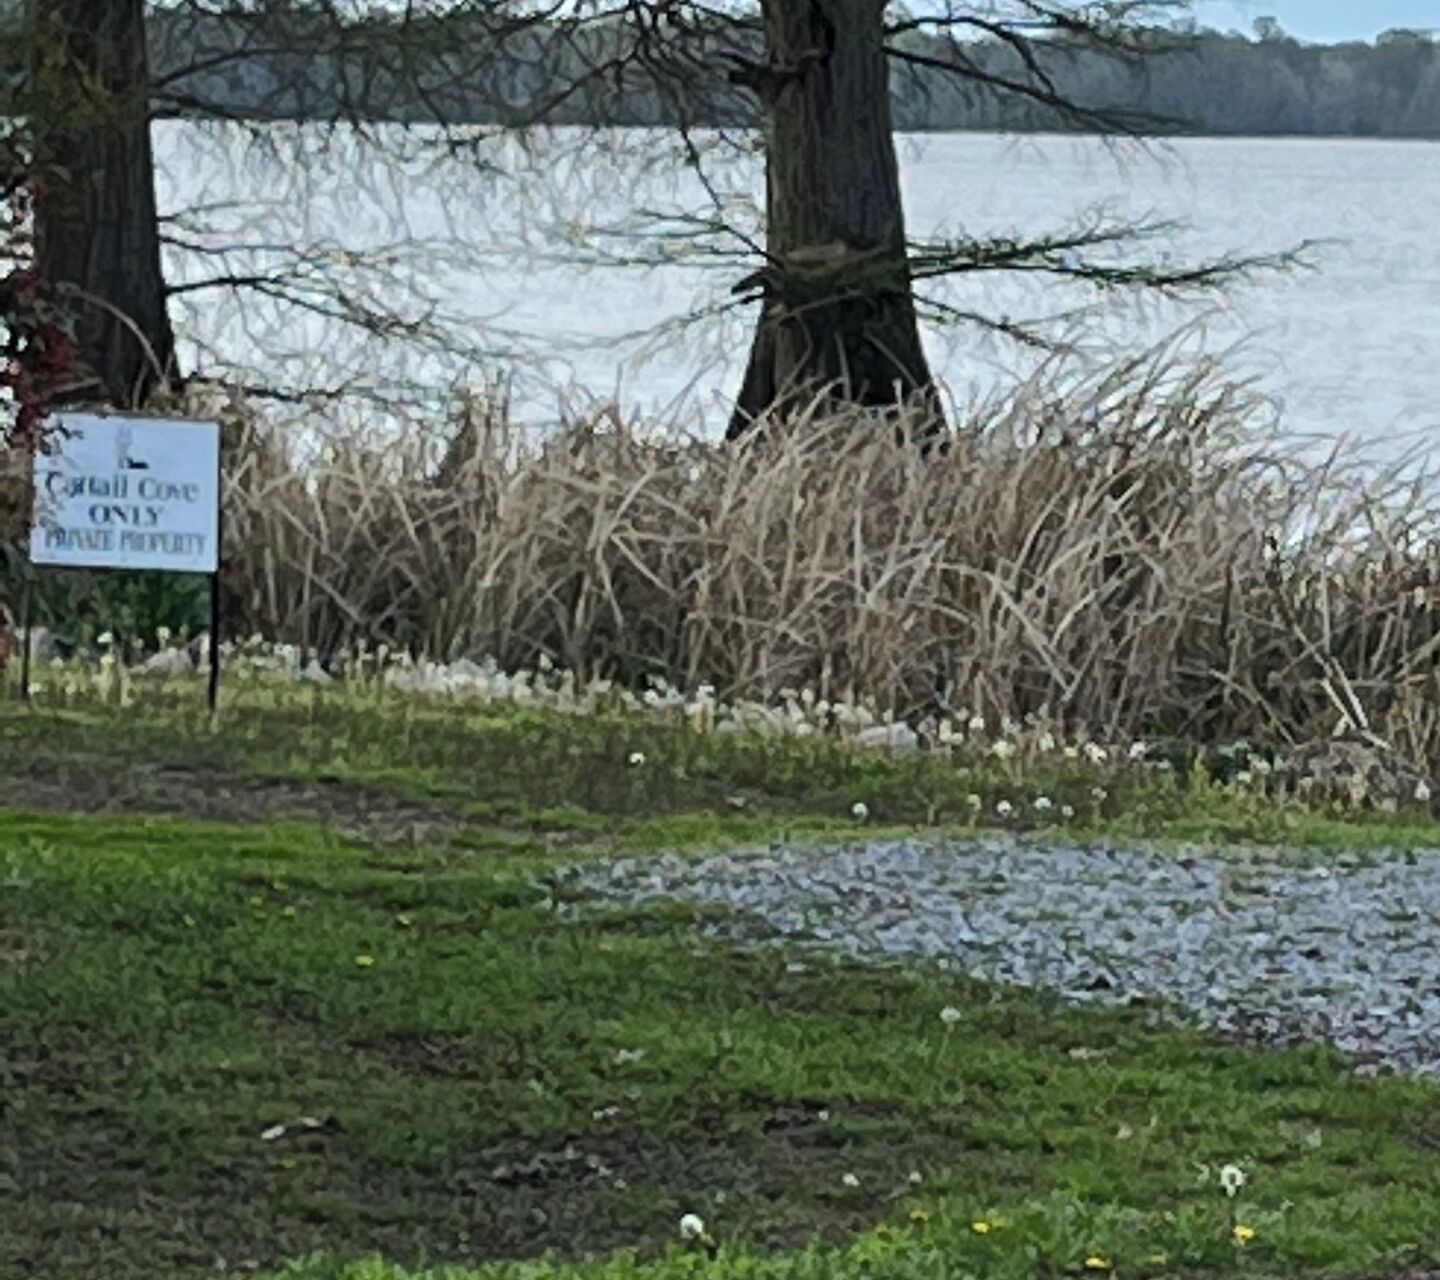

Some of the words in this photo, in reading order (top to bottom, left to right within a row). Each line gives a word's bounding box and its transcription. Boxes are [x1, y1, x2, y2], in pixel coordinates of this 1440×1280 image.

[138, 477, 199, 502] Cove
[88, 504, 164, 527] ONLY
[44, 527, 113, 551] PRIVATE
[120, 530, 206, 556] PROPERTY
